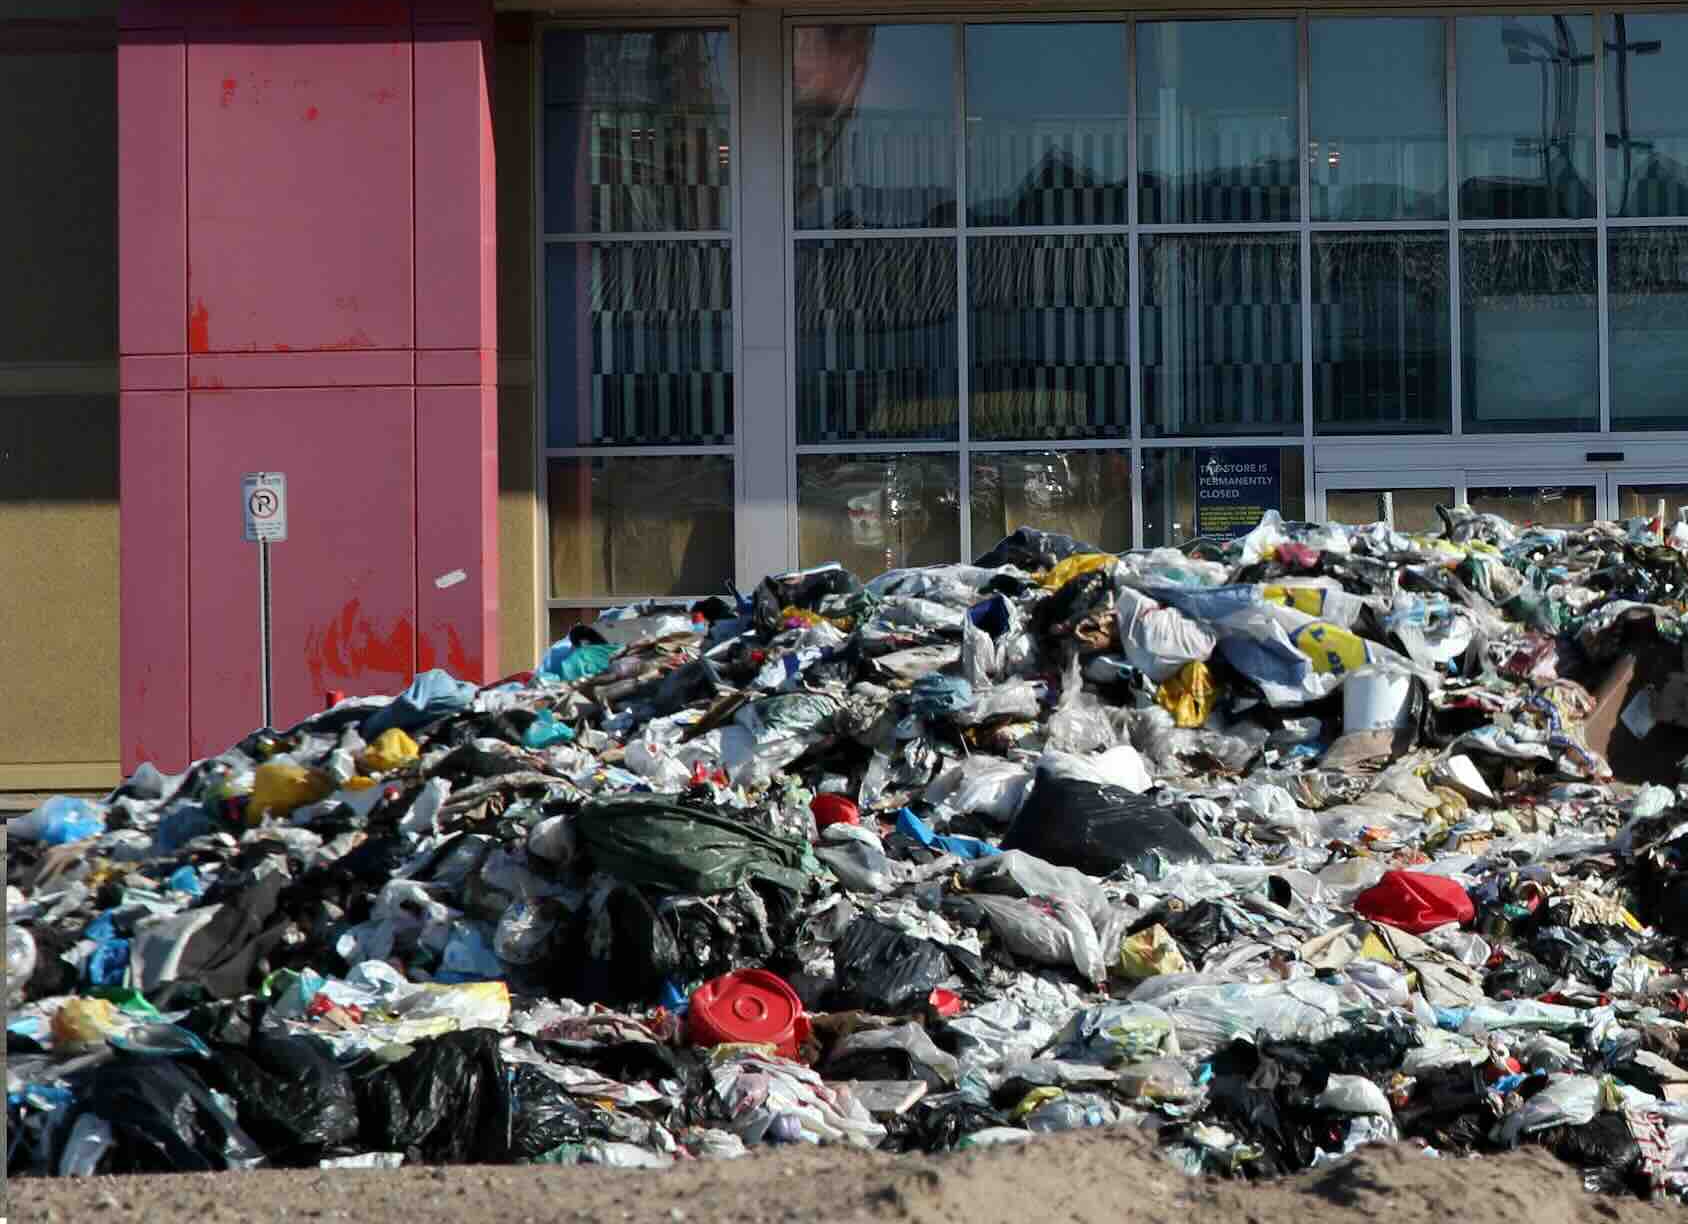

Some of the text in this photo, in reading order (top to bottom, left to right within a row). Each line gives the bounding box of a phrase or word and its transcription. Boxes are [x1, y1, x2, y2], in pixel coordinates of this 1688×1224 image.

[1200, 463, 1268, 473] THS STORE IS
[1200, 476, 1273, 486] PERMANENTLY
